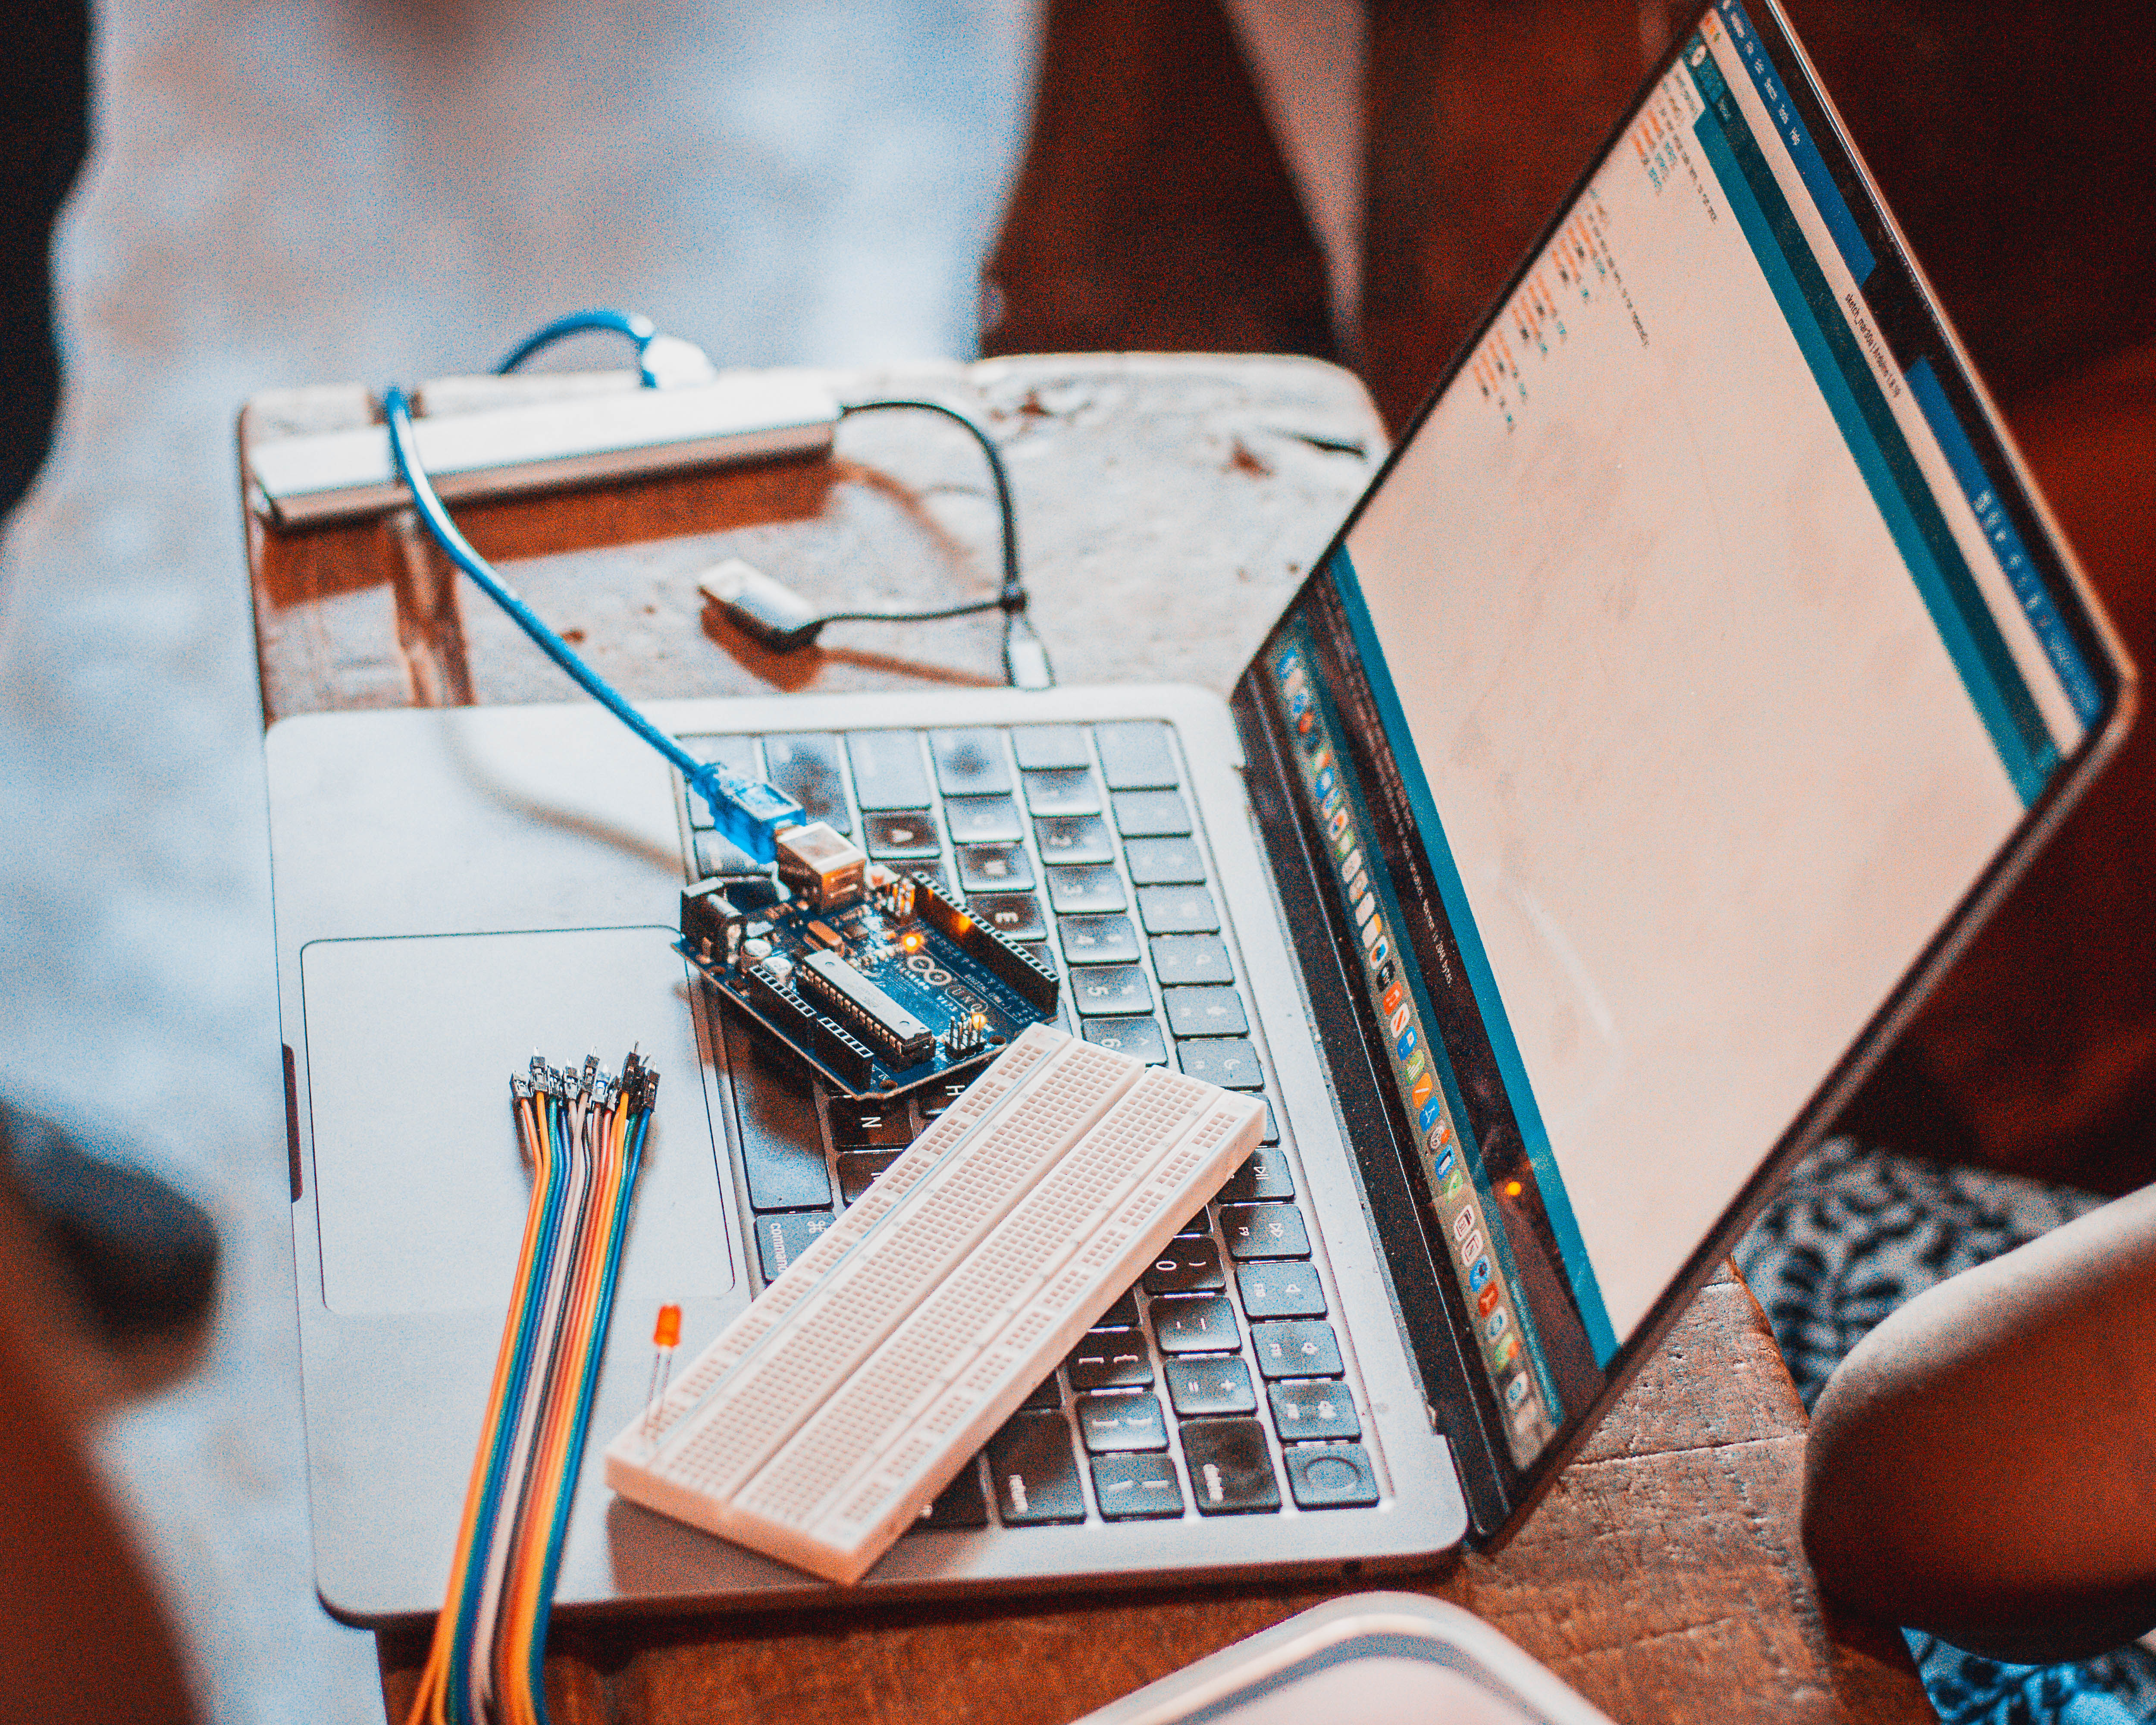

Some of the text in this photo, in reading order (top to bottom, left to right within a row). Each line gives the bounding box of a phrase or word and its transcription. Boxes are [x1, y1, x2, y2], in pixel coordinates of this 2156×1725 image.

[995, 911, 1019, 924] E
[1442, 959, 1453, 988] bytes.
[1087, 985, 1109, 996] 5
[1101, 1038, 1122, 1048] 6
[945, 1085, 965, 1096] H
[861, 1116, 883, 1128] N
[1238, 1226, 1250, 1236] F9
[1253, 1283, 1266, 1298] F10
[1270, 1342, 1282, 1357] F11
